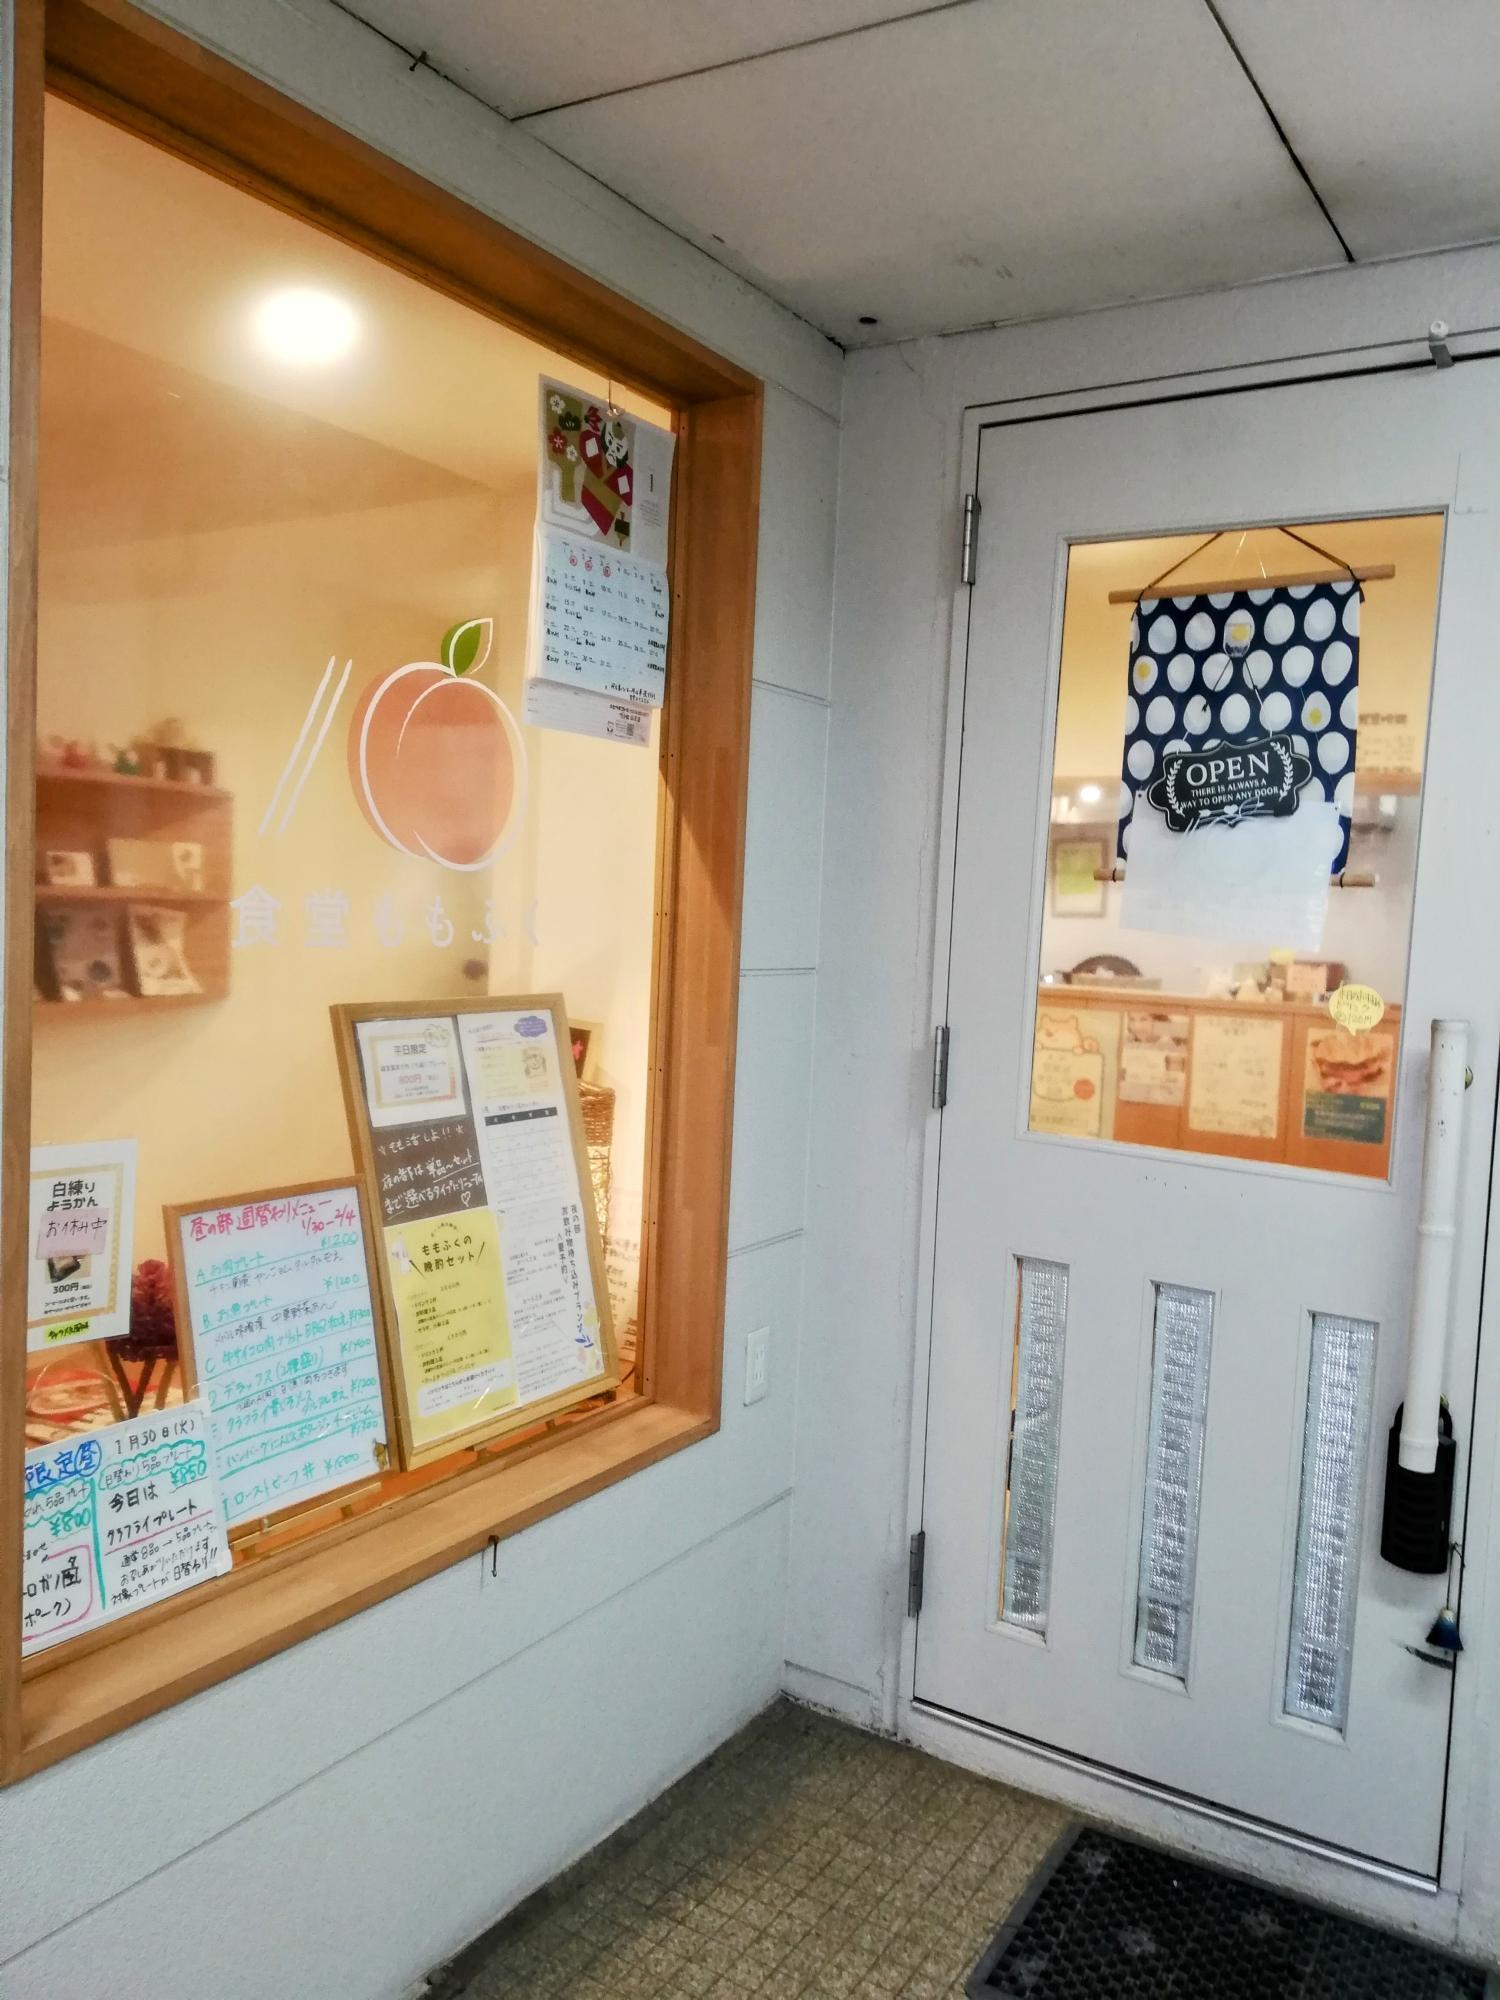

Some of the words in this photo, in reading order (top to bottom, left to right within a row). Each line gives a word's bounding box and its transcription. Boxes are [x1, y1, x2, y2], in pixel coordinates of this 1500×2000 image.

[1186, 751, 1269, 786] OPEN
[1181, 800, 1197, 809] WAY
[1200, 798, 1210, 806] TO
[1212, 794, 1233, 804] OPEN
[1235, 790, 1252, 800] ANY
[1255, 786, 1279, 798] DOOR
[1191, 786, 1216, 798] THERE
[1218, 785, 1225, 793] IS
[1228, 778, 1259, 791] ALWAYS
[1261, 778, 1267, 786] A
[52, 1179, 96, 1198] 白練り
[46, 1196, 99, 1212] ようかん
[46, 1217, 108, 1241] お休み中
[422, 1235, 472, 1256] ももふくの
[424, 1251, 474, 1272] 晩酌セット
[52, 1282, 79, 1294] 300円
[115, 1419, 195, 1455] 1月30日(火)
[169, 1460, 207, 1487] ¥850
[108, 1480, 159, 1513] 今日は
[49, 1508, 92, 1536] ¥800
[107, 1498, 198, 1546] タラフライプレート
